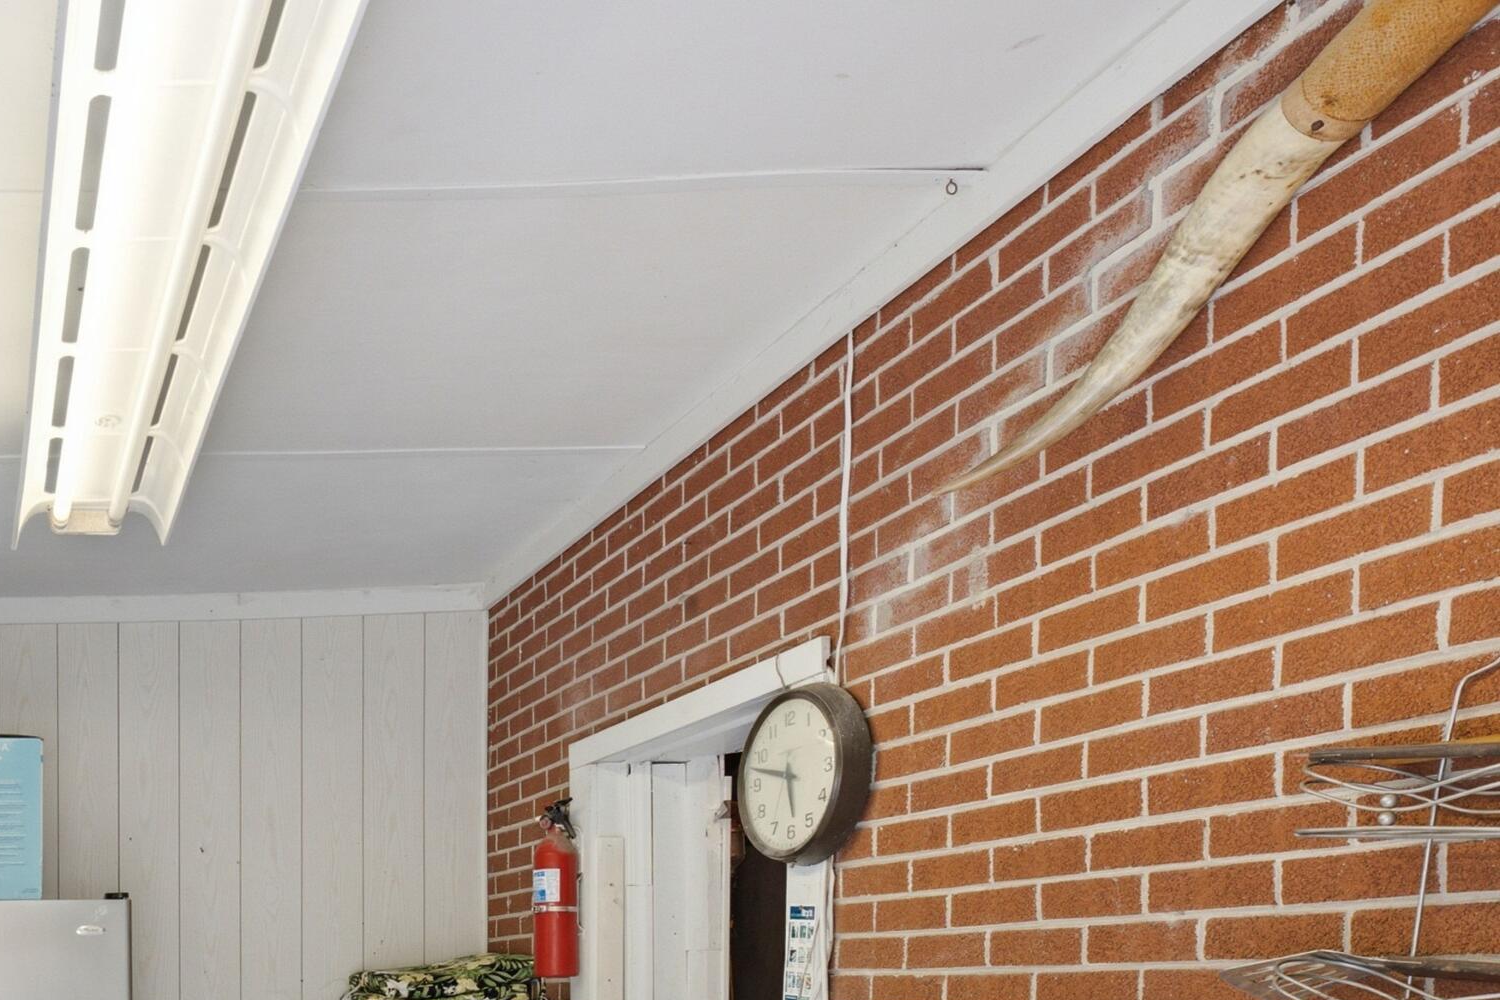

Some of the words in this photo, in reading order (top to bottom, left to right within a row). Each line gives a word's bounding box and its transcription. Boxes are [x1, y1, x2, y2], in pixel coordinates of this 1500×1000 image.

[785, 710, 796, 727] 12
[807, 712, 811, 727] 1
[769, 724, 778, 739] 11
[756, 748, 768, 764] 10
[824, 756, 833, 772] 3
[753, 777, 762, 792] 9
[818, 788, 827, 802] 4
[758, 803, 766, 819] 8
[805, 812, 814, 828] 5
[770, 821, 779, 836] 7
[787, 825, 796, 840] 6
